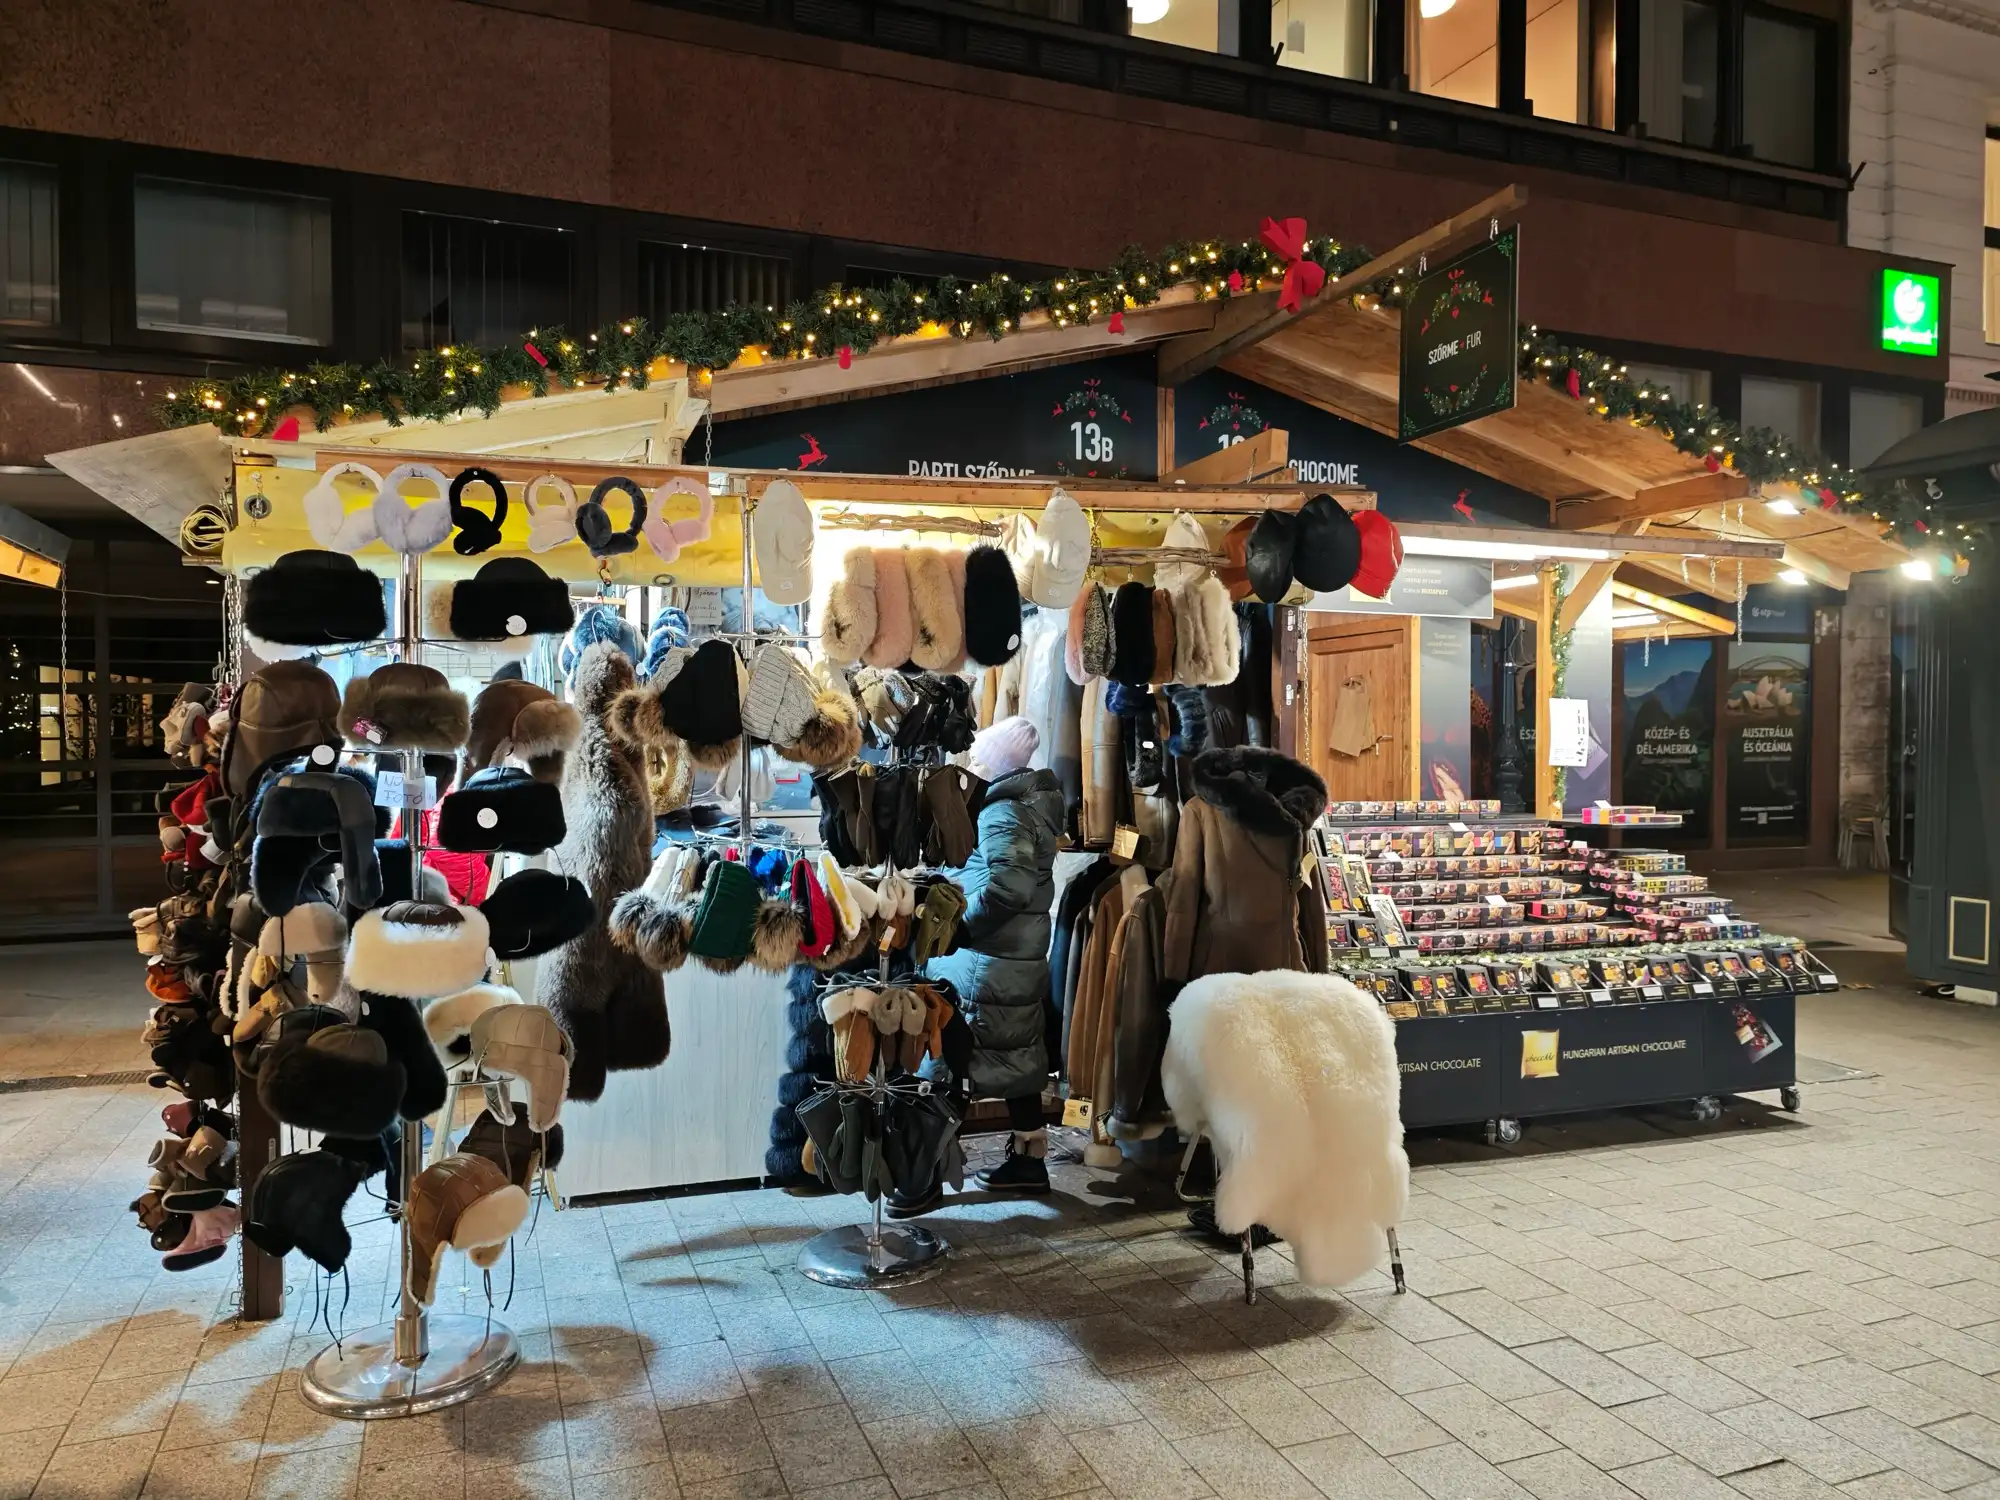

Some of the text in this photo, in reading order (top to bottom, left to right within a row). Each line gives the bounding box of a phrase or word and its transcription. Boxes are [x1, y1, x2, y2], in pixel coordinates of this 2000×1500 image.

[1428, 331, 1482, 365] SZŐRME FUR
[1070, 421, 1114, 463] 13B
[1519, 726, 1537, 740] ÉSZ
[1679, 726, 1691, 739] ÉS
[1742, 725, 1794, 738] AUSZTRÁLIA
[1636, 741, 1698, 755] DÉL-AMERIKA
[1743, 740, 1754, 752] ÉS
[1563, 1039, 1687, 1060] HUNGARIAN ARTISAN CHOCOLATE
[1398, 1058, 1481, 1073] RTISAN CHOCOLATE
